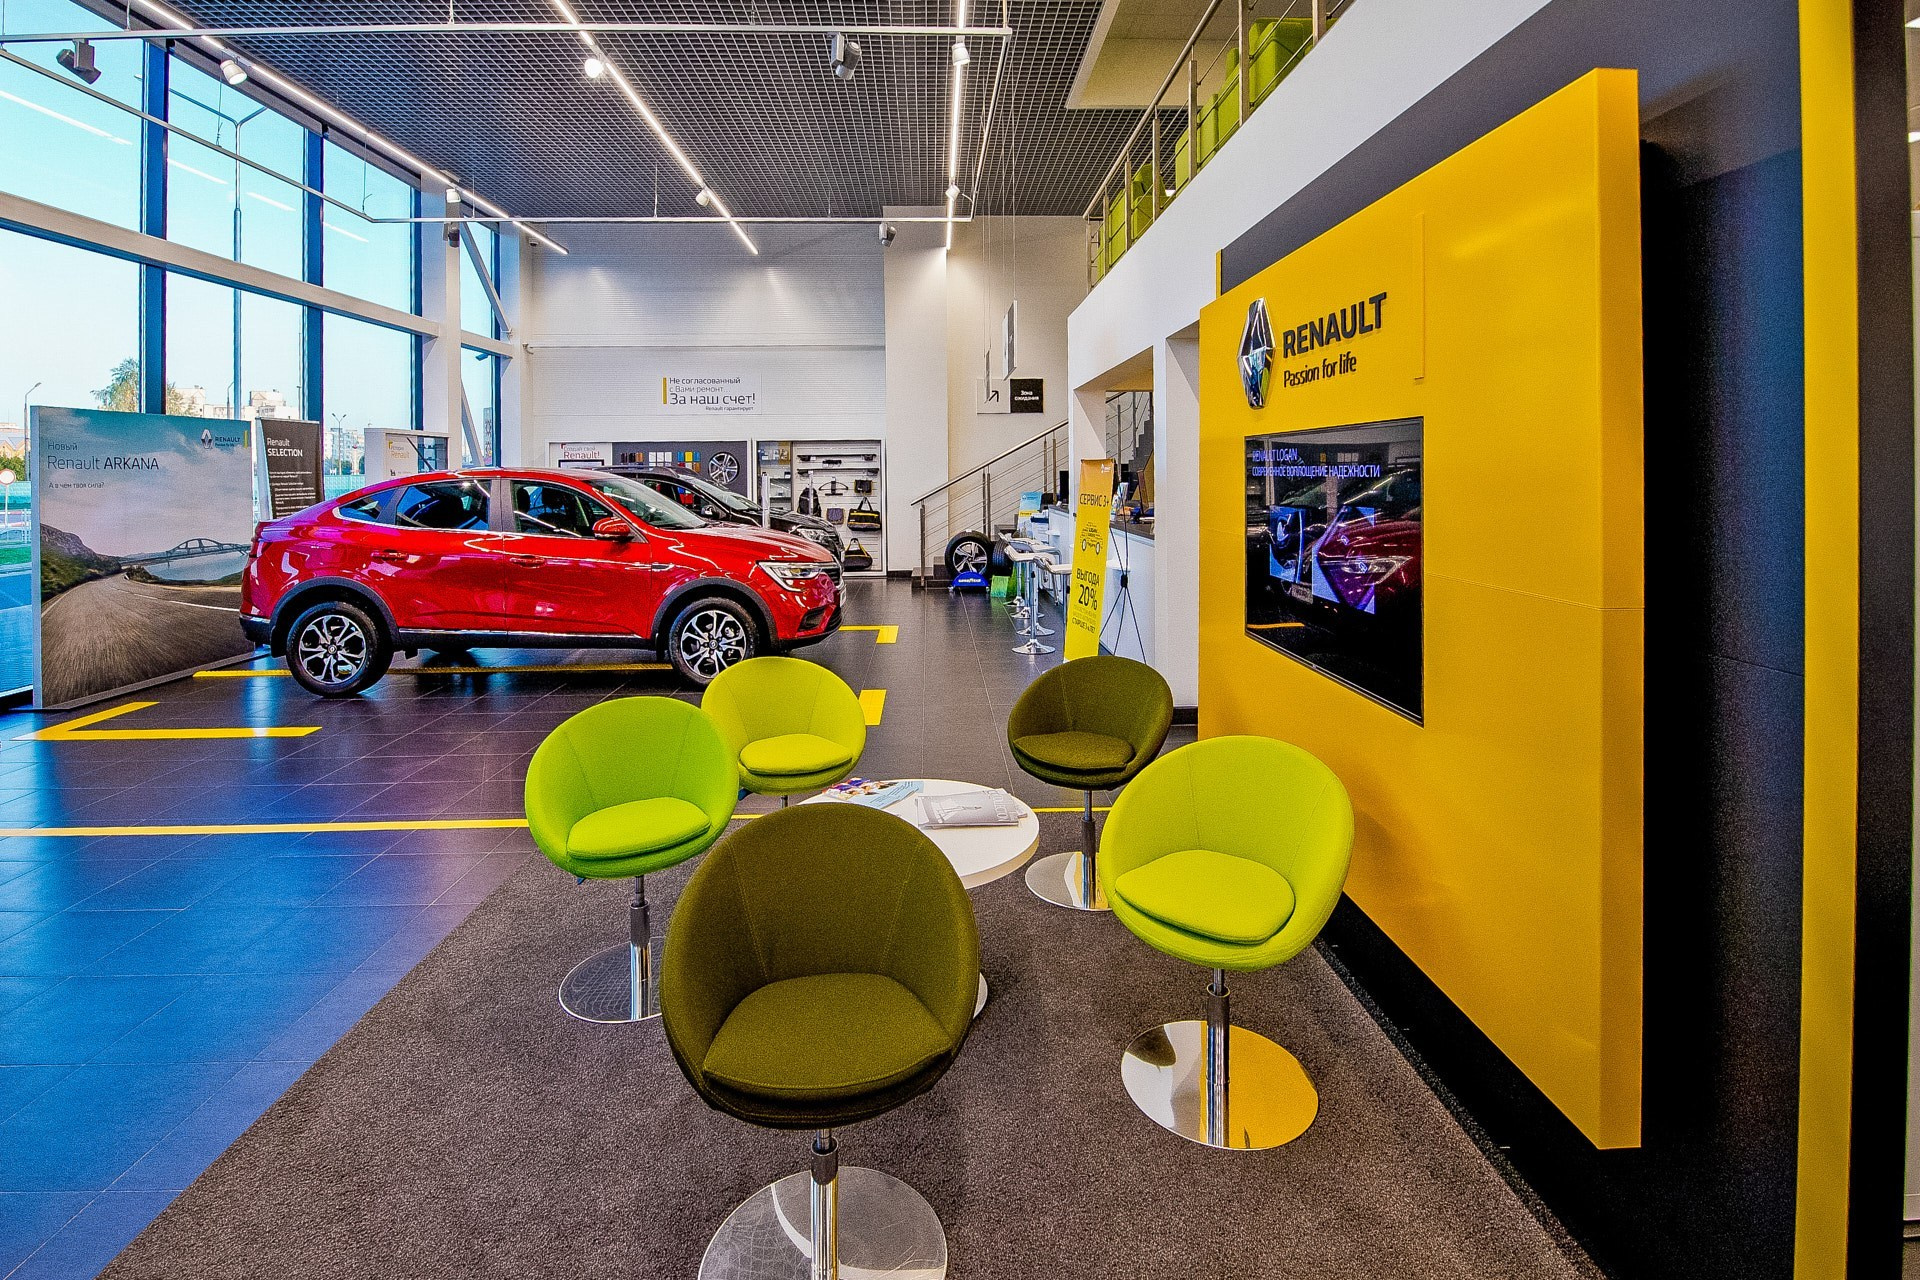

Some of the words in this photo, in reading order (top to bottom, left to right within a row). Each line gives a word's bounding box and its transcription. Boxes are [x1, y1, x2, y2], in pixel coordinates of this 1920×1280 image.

[1282, 291, 1387, 358] RENAULT
[1283, 364, 1320, 388] Passion
[1322, 358, 1338, 379] for
[1339, 351, 1357, 375] life
[669, 377, 680, 385] Не
[681, 377, 741, 385] согласованный
[669, 393, 687, 405] За
[690, 395, 719, 405] наш
[722, 393, 756, 405] счет!
[47, 441, 78, 451] Новый
[266, 437, 290, 447] Renault
[267, 448, 303, 457] SELECTION
[563, 450, 600, 459] Renault!
[1276, 448, 1298, 462] LOGAN
[47, 455, 101, 470] Renault
[103, 456, 160, 470] ARKANA
[1287, 465, 1329, 479] ВОПЛОЩЕНИЕ
[1329, 464, 1380, 479] НАДЕЖНОСТИ
[87, 481, 105, 489] сила?
[1079, 493, 1103, 508] СЕРВИС
[1103, 495, 1110, 508] 3+
[1076, 567, 1100, 586] ВЫГОДА
[1078, 583, 1098, 611] 20%
